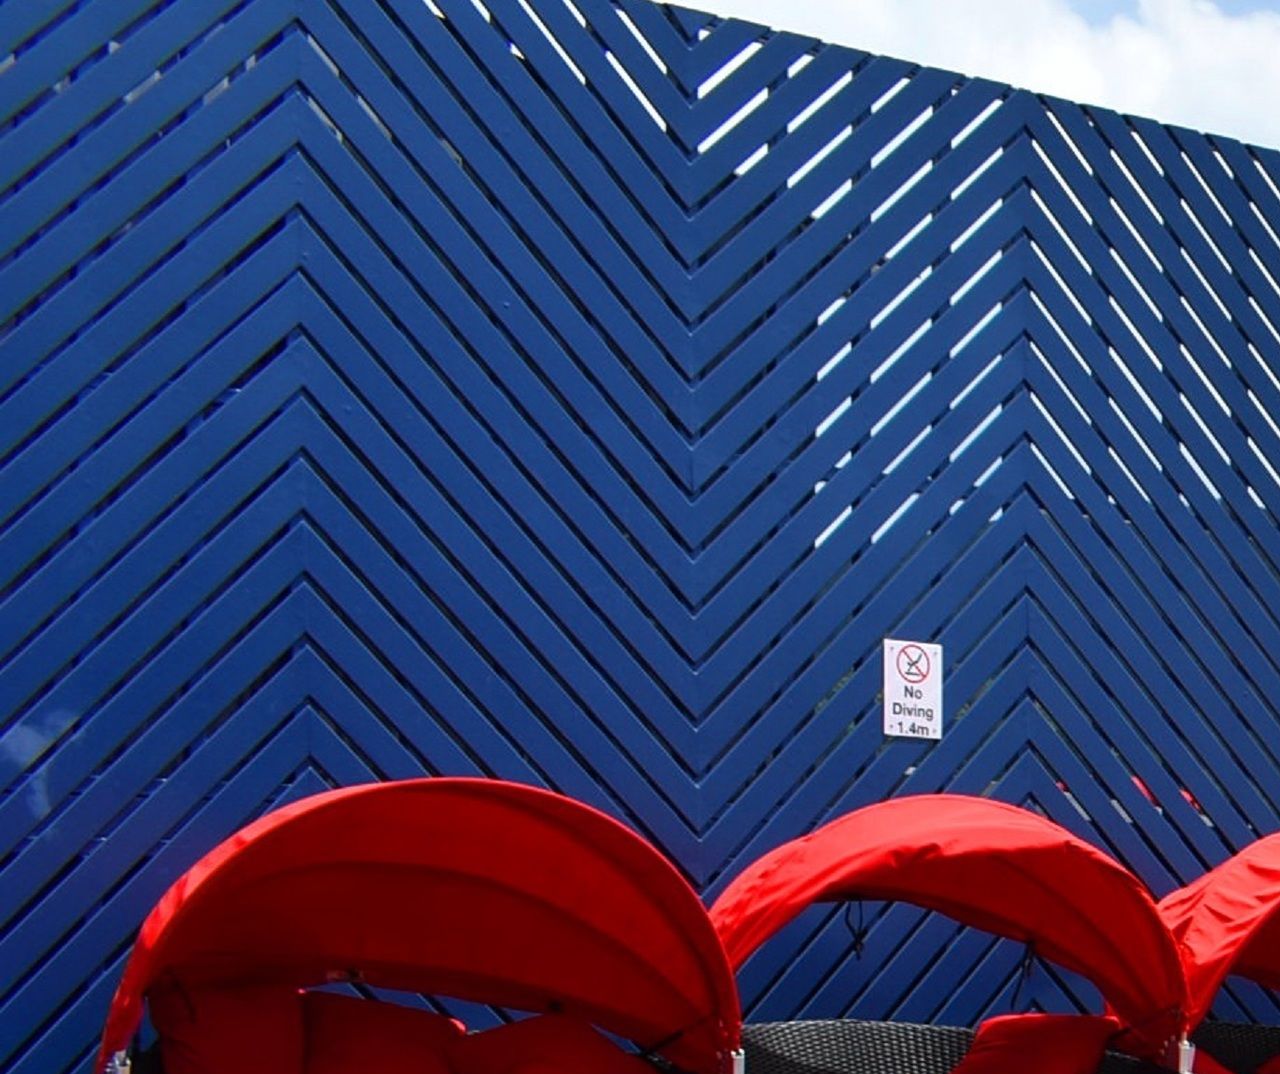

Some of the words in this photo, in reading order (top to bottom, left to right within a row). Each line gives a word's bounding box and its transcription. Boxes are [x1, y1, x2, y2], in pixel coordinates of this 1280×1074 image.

[904, 685, 923, 699] No
[892, 702, 934, 721] Diving
[897, 721, 930, 736] 1.4m
